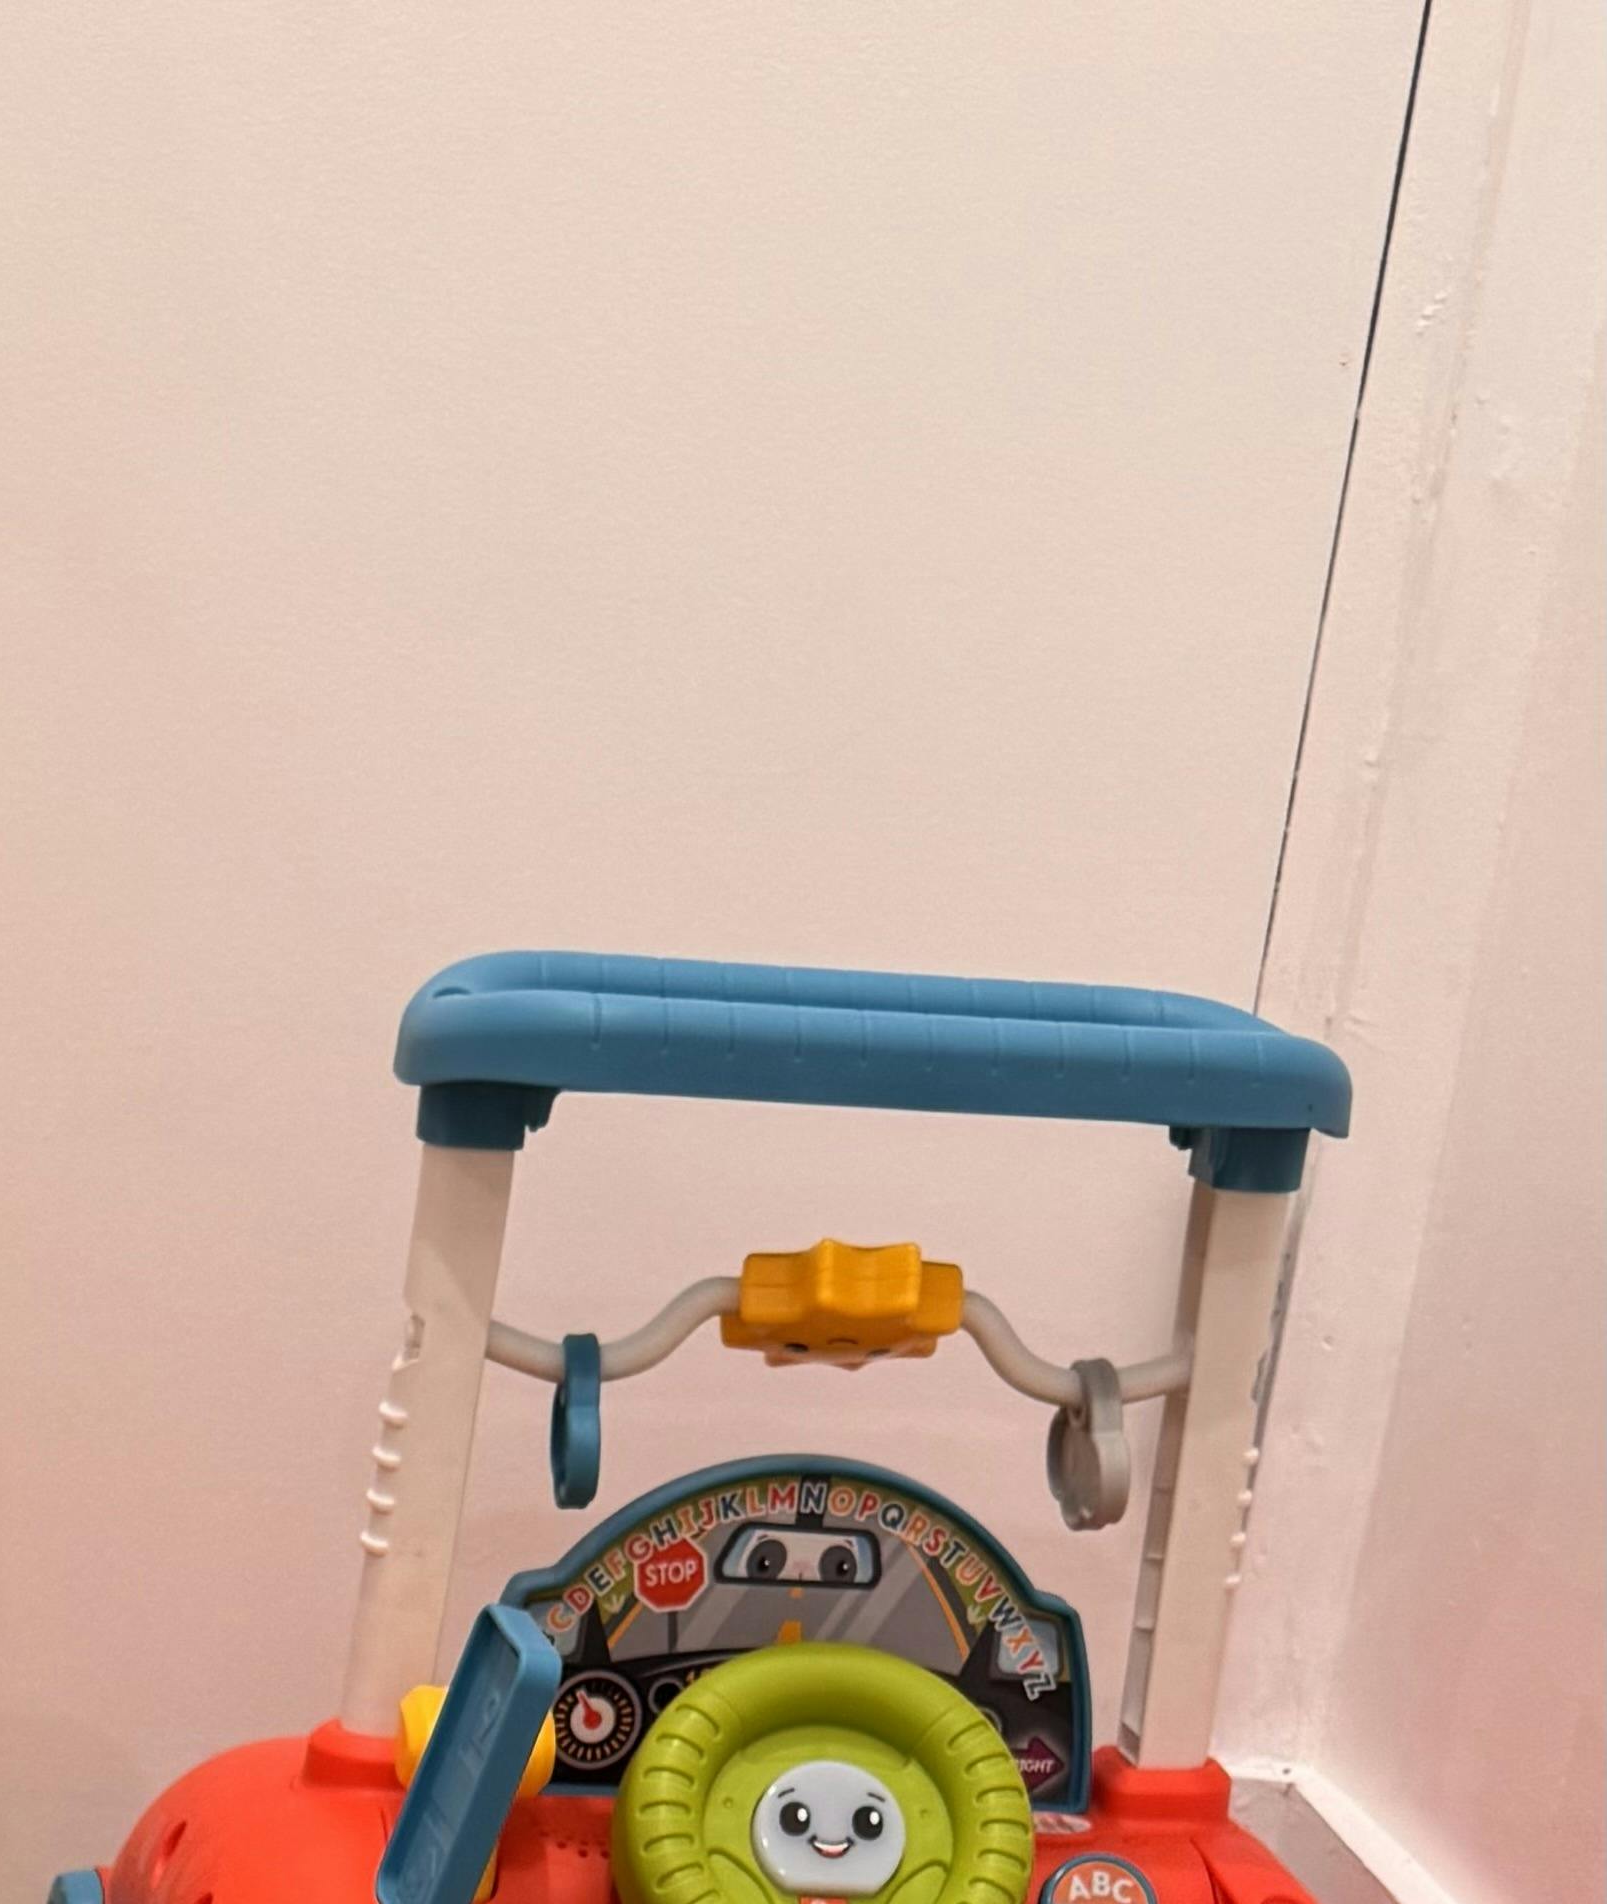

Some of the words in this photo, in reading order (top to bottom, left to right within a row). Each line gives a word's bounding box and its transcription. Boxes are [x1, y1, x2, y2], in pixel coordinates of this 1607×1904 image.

[645, 1561, 698, 1588] STOP
[1015, 1759, 1054, 1773] IGHT
[1068, 1871, 1134, 1904] ABC
